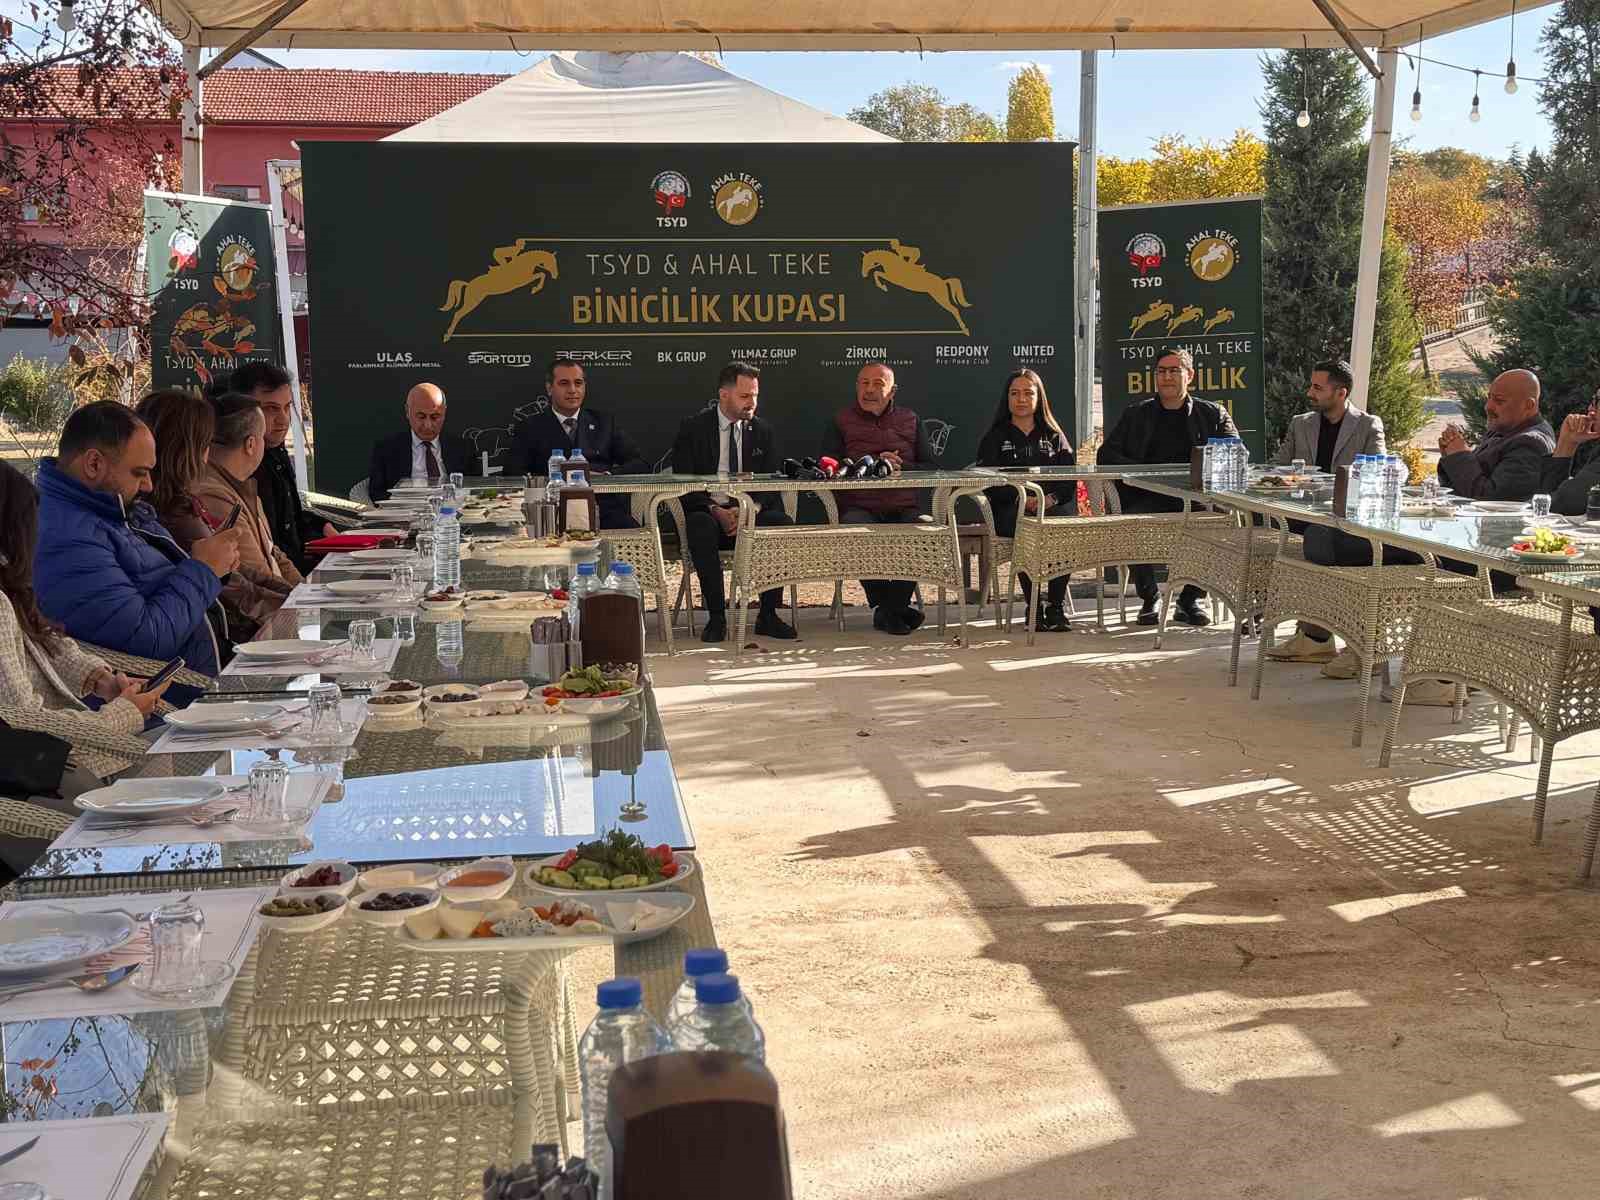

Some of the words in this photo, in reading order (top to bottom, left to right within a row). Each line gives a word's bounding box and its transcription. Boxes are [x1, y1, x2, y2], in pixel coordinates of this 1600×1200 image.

[710, 172, 737, 194] AHAL
[739, 172, 762, 192] TEKE
[656, 217, 688, 228] TSYD
[216, 235, 235, 256] AHAL
[238, 235, 257, 256] TEKE
[1185, 230, 1211, 251] AHAL
[1215, 229, 1239, 248] TEKE
[586, 254, 651, 276] TSYD
[663, 254, 679, 276] &
[690, 253, 758, 276] AHAL
[768, 253, 832, 275] TEKE
[1131, 277, 1163, 289] TSYD
[572, 287, 722, 324] BİNİCİLİK
[732, 293, 846, 322] KUPASI
[554, 350, 633, 361] BERKER
[731, 349, 768, 359] YILMAZ
[770, 349, 797, 359] GRUP
[846, 345, 887, 359] ZİRKON
[936, 345, 989, 357] REDPONY
[1013, 345, 1055, 357] UNITED
[1120, 346, 1155, 360] TSYD
[1177, 342, 1212, 355] HAL
[1218, 340, 1252, 353] TEKE
[376, 352, 413, 363] ULAŞ
[467, 353, 532, 365] SPORTOTO
[657, 351, 673, 362] BK
[675, 351, 707, 362] GRUP
[1127, 361, 1248, 394] BİİLİK
